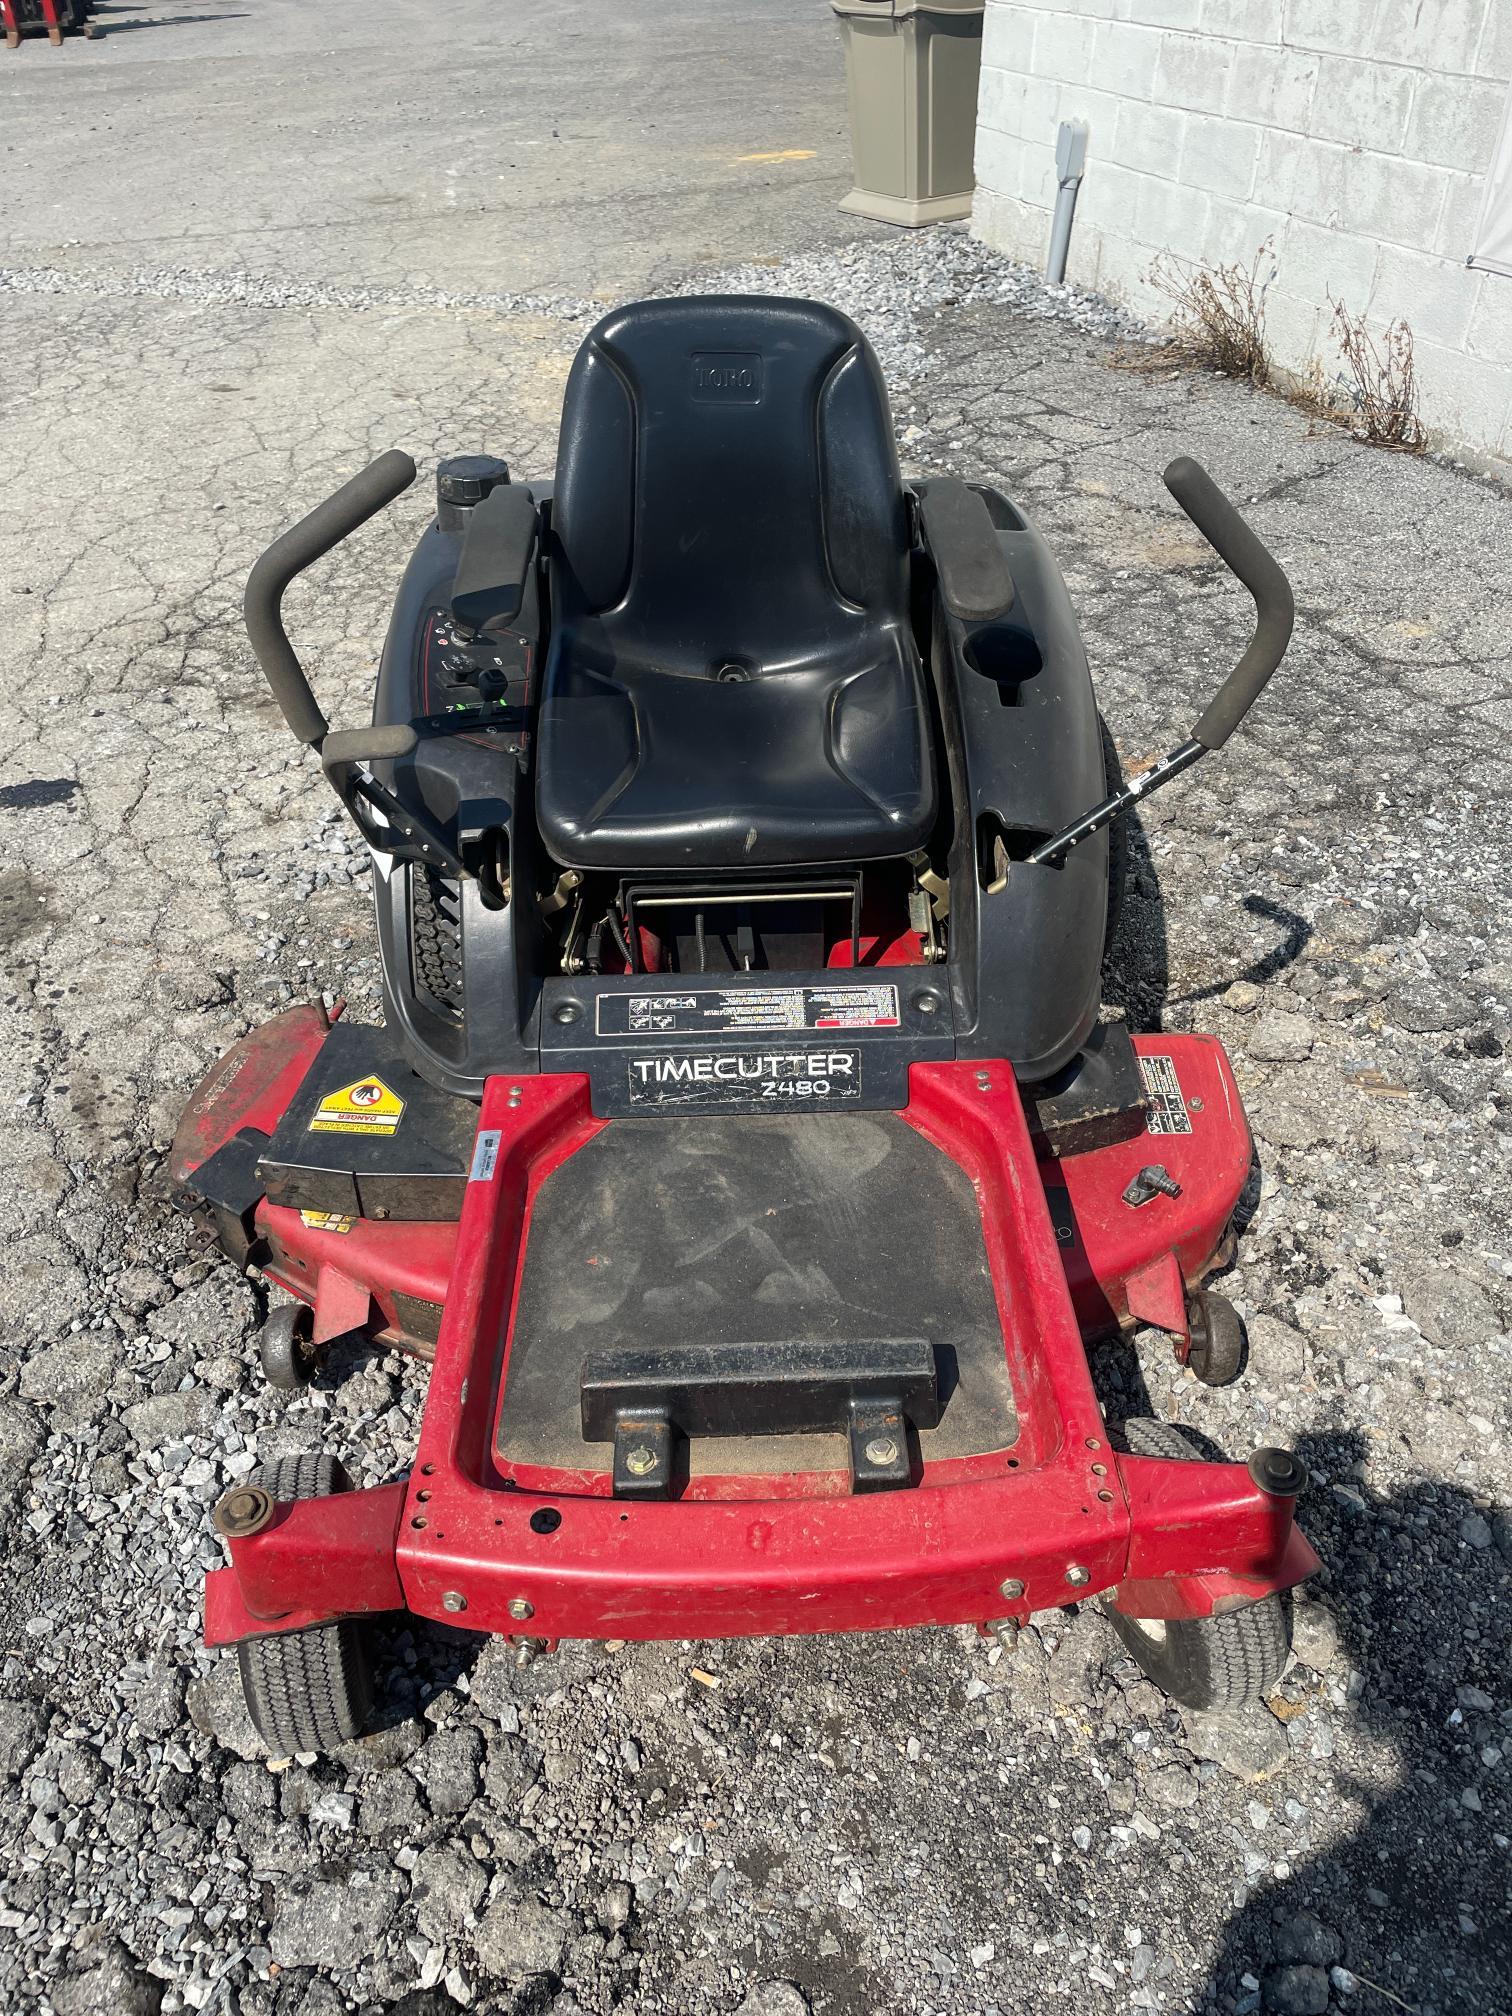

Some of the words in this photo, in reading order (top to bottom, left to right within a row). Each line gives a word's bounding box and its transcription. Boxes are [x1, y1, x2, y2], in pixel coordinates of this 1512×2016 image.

[695, 367, 753, 387] TORO
[633, 1053, 855, 1082] TIMECUTTER
[760, 1080, 830, 1097] Z480
